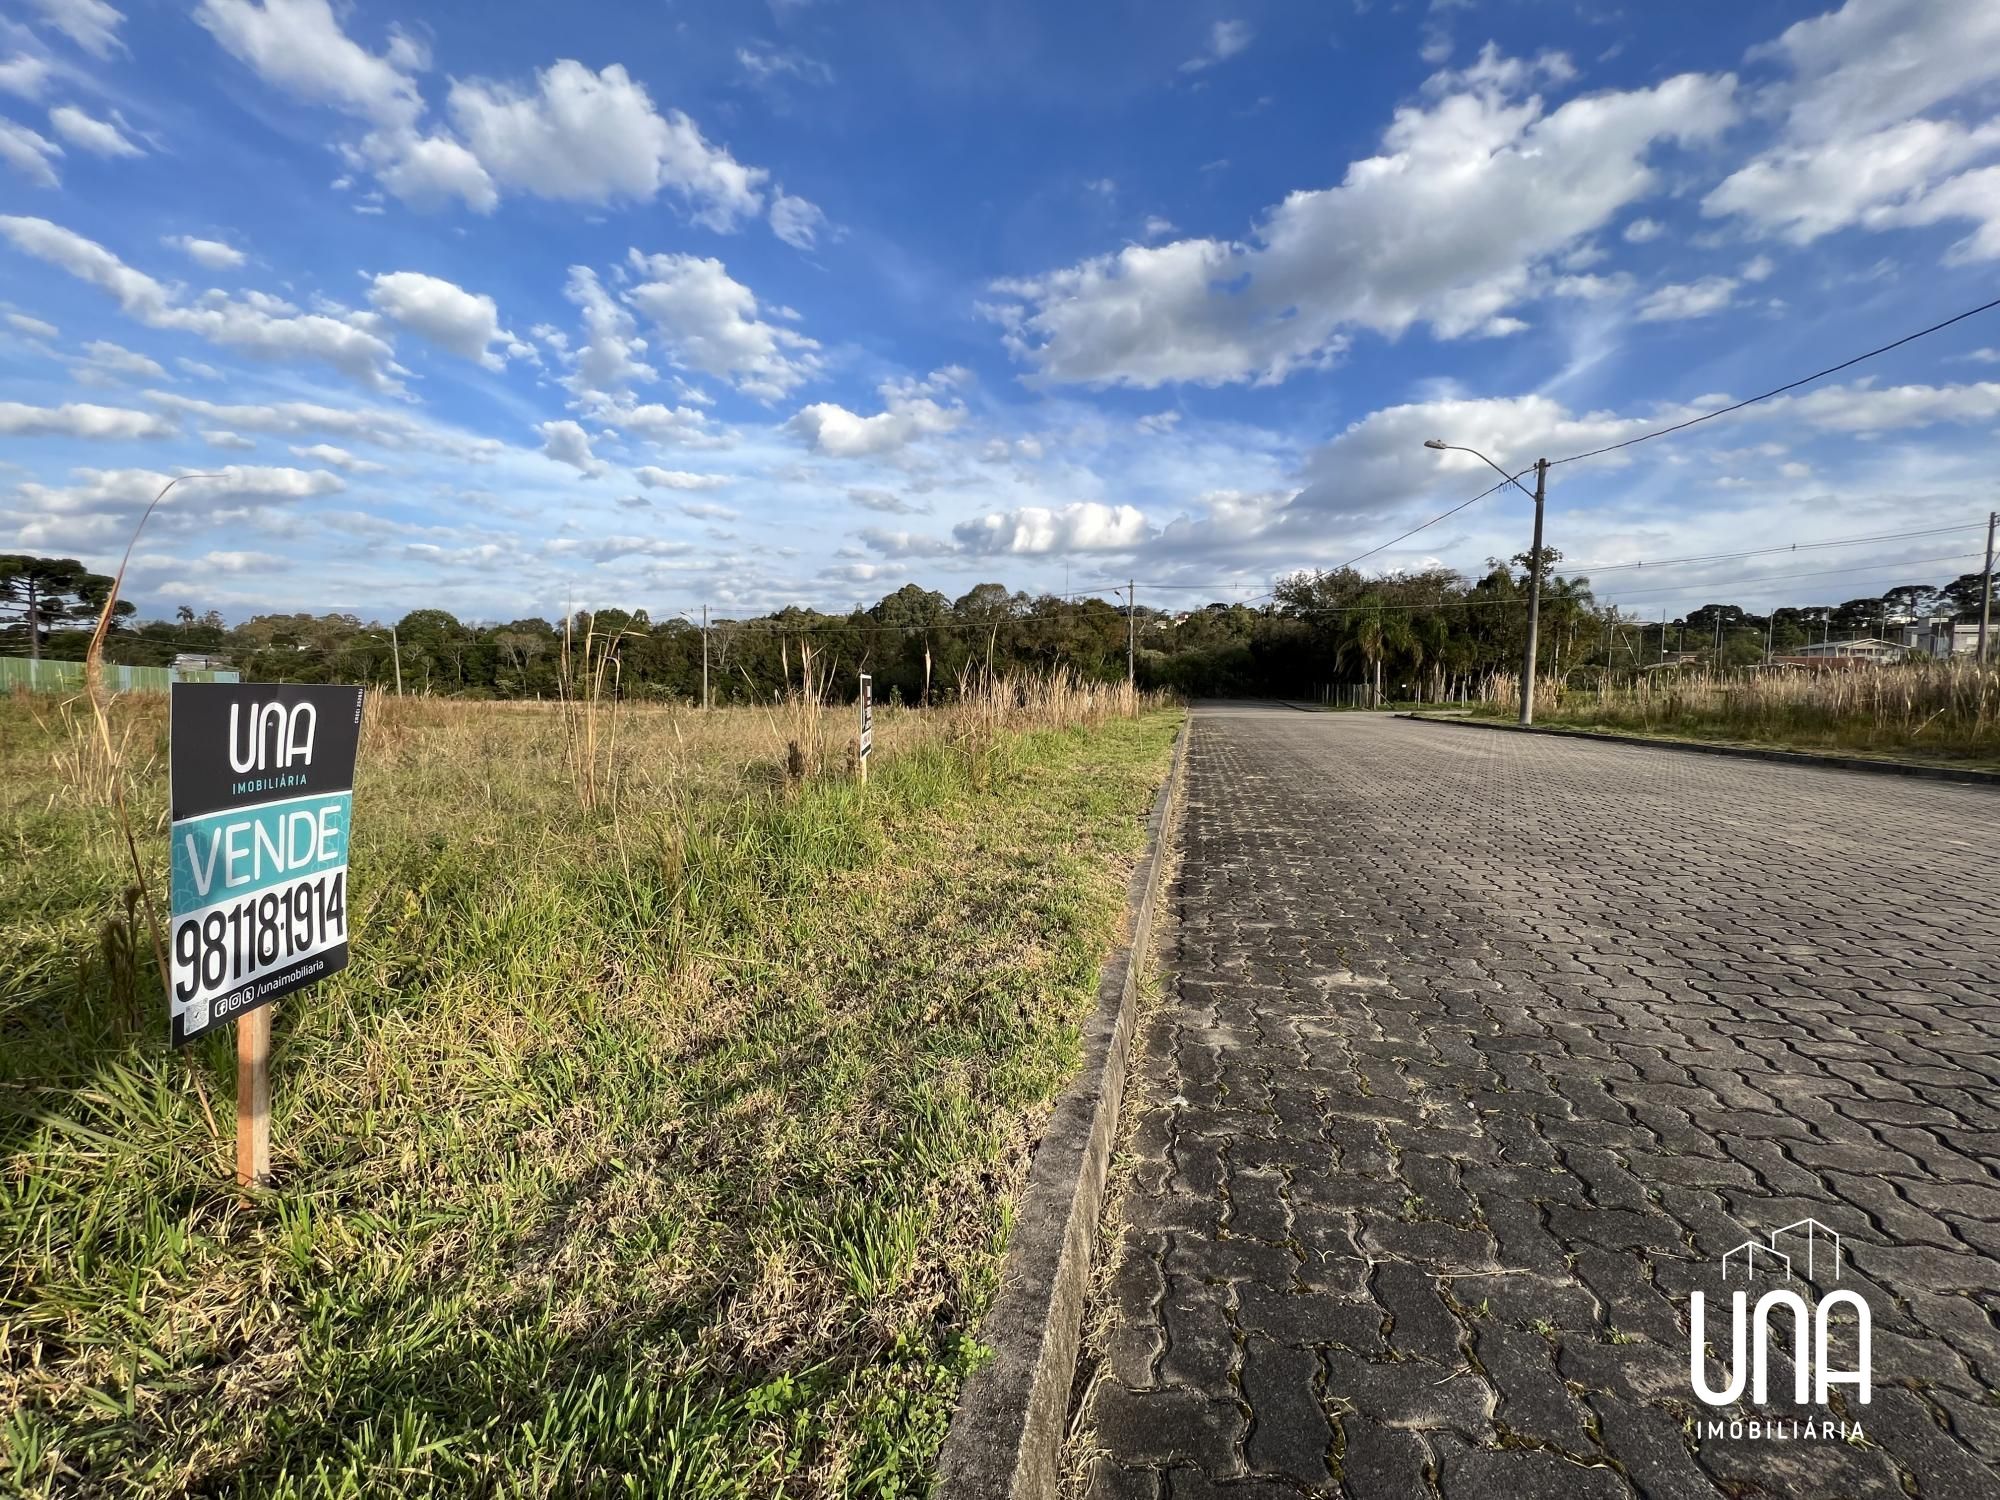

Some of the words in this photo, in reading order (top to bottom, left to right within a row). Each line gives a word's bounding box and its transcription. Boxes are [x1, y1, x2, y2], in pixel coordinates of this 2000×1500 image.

[229, 702, 317, 774] UNA
[232, 774, 307, 795] IMOBILIÁRIA
[185, 805, 341, 897] VENDE
